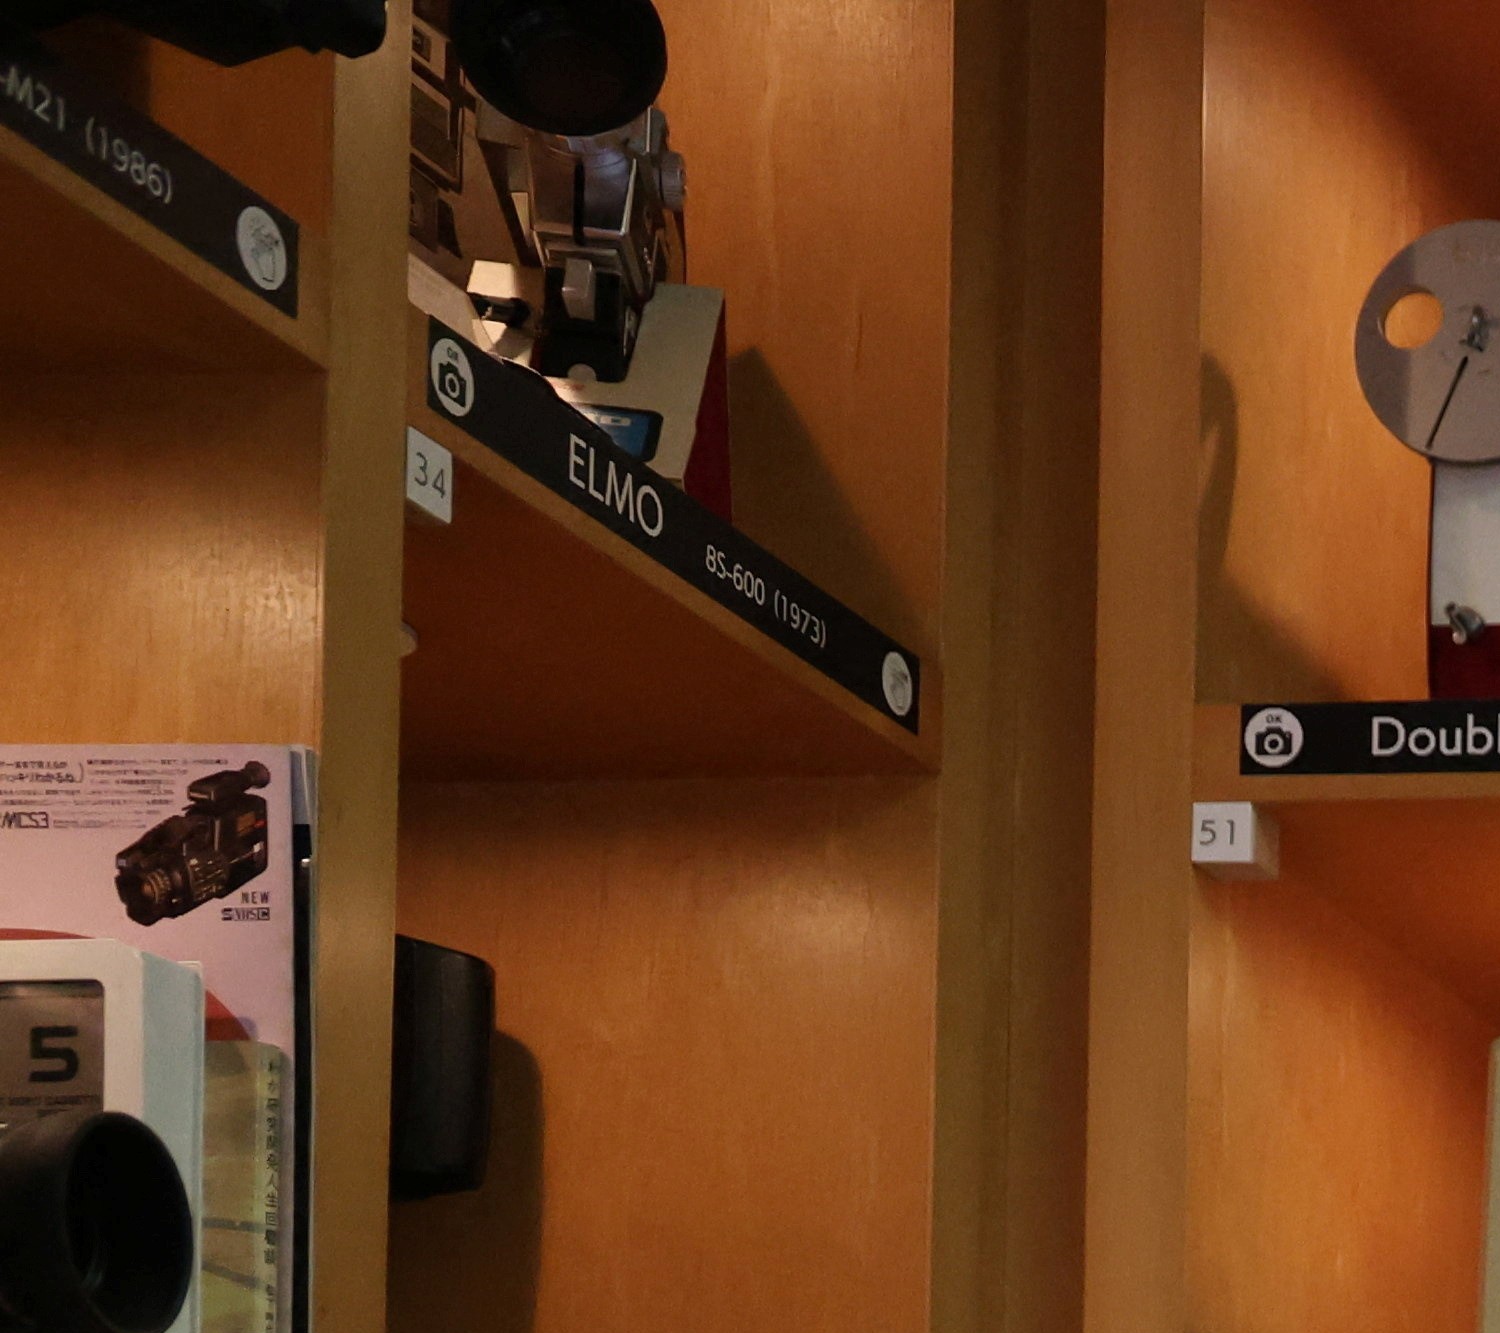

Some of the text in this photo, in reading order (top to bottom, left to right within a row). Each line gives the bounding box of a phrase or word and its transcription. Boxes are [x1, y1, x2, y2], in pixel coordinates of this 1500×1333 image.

[85, 117, 173, 204] (1986)
[414, 452, 446, 499] 34
[568, 432, 664, 538] ELMO
[774, 589, 828, 648] (1973)
[1199, 818, 1239, 847] 51
[241, 891, 270, 904] NEW
[29, 1026, 79, 1082] 5
